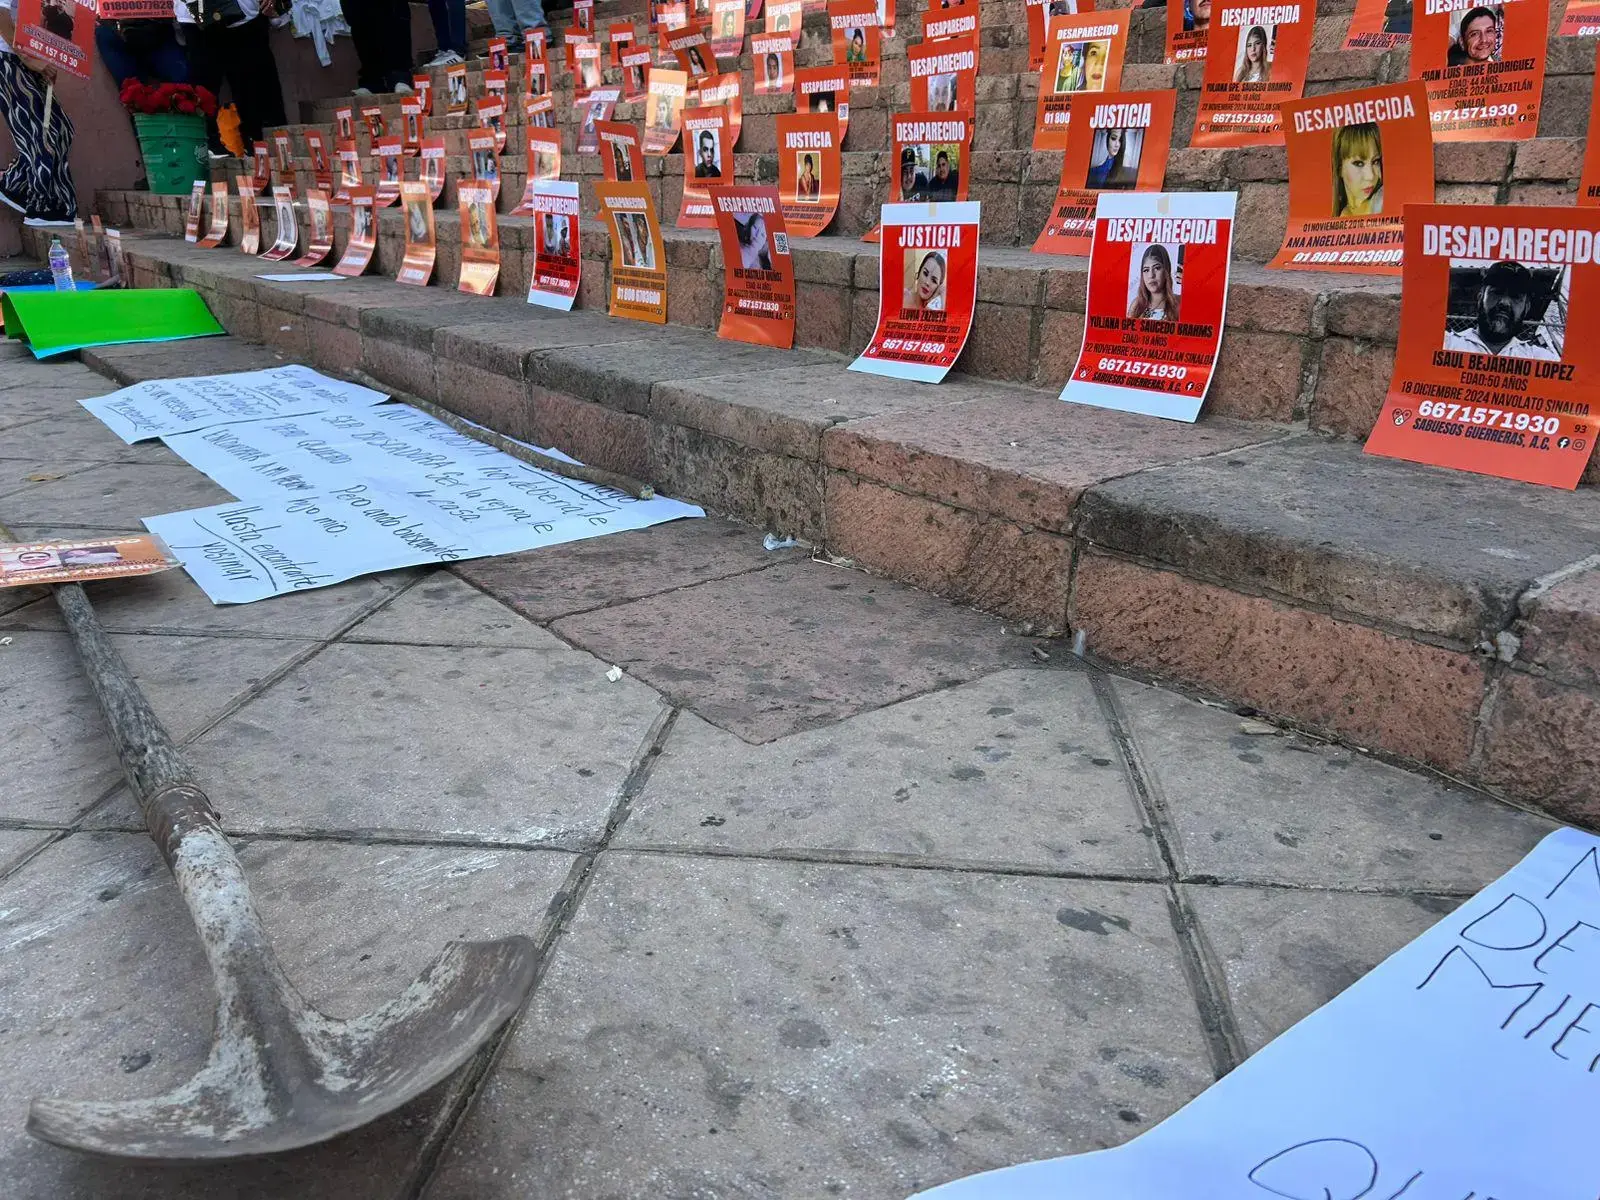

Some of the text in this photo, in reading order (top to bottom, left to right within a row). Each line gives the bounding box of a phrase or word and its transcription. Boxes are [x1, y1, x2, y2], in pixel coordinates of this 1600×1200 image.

[926, 15, 976, 38] DESAPARECIDO
[1221, 4, 1300, 27] DESAPARECIDA
[1057, 24, 1118, 40] DESAPARECIDO
[45, 45, 58, 58] 157
[59, 52, 68, 63] 19
[910, 50, 975, 78] DESAPARECIDO
[1443, 67, 1462, 79] LUIS
[1463, 64, 1485, 77] IRIBE
[1487, 58, 1536, 75] RODRIGUEZ
[1469, 85, 1490, 97] 2024
[1491, 79, 1533, 94] MAZATLÁN
[1044, 111, 1071, 124] 01 800
[1090, 103, 1152, 129] JUSTICIA
[1212, 113, 1274, 123] 6671571930
[1293, 95, 1415, 133] DESAPARECIDA
[786, 131, 832, 148] JUSTICIA
[896, 121, 966, 142] DESAPARECIDO
[717, 196, 776, 214] DESAPARECIDA
[1056, 206, 1088, 220] MIRIAM
[898, 225, 961, 247] JUSTICIA
[1106, 218, 1217, 244] DESAPARECIDA
[1286, 236, 1306, 248] ANA
[1377, 230, 1404, 244] REYN
[1090, 316, 1119, 330] YULIANA
[1140, 320, 1176, 335] SAUCEDO
[1178, 323, 1214, 338] BRAHMS
[1094, 343, 1129, 357] NOVIEMBRE
[1130, 347, 1147, 358] 2024
[1098, 357, 1187, 380] 6671571930
[1432, 350, 1576, 382] ISAUL BEJARANO LOPEZ
[1501, 375, 1529, 392] AÑOS
[1400, 380, 1590, 417] 18 DICIEMBRE 2024 NAVOLATO SINALOA
[1418, 399, 1587, 435] 6671571930 93
[1412, 417, 1464, 437] SABUESOS
[1464, 425, 1526, 448] GUERRERAS,
[217, 505, 283, 543] Hasta
[362, 508, 408, 527] ando
[1416, 944, 1600, 1073] MIE
